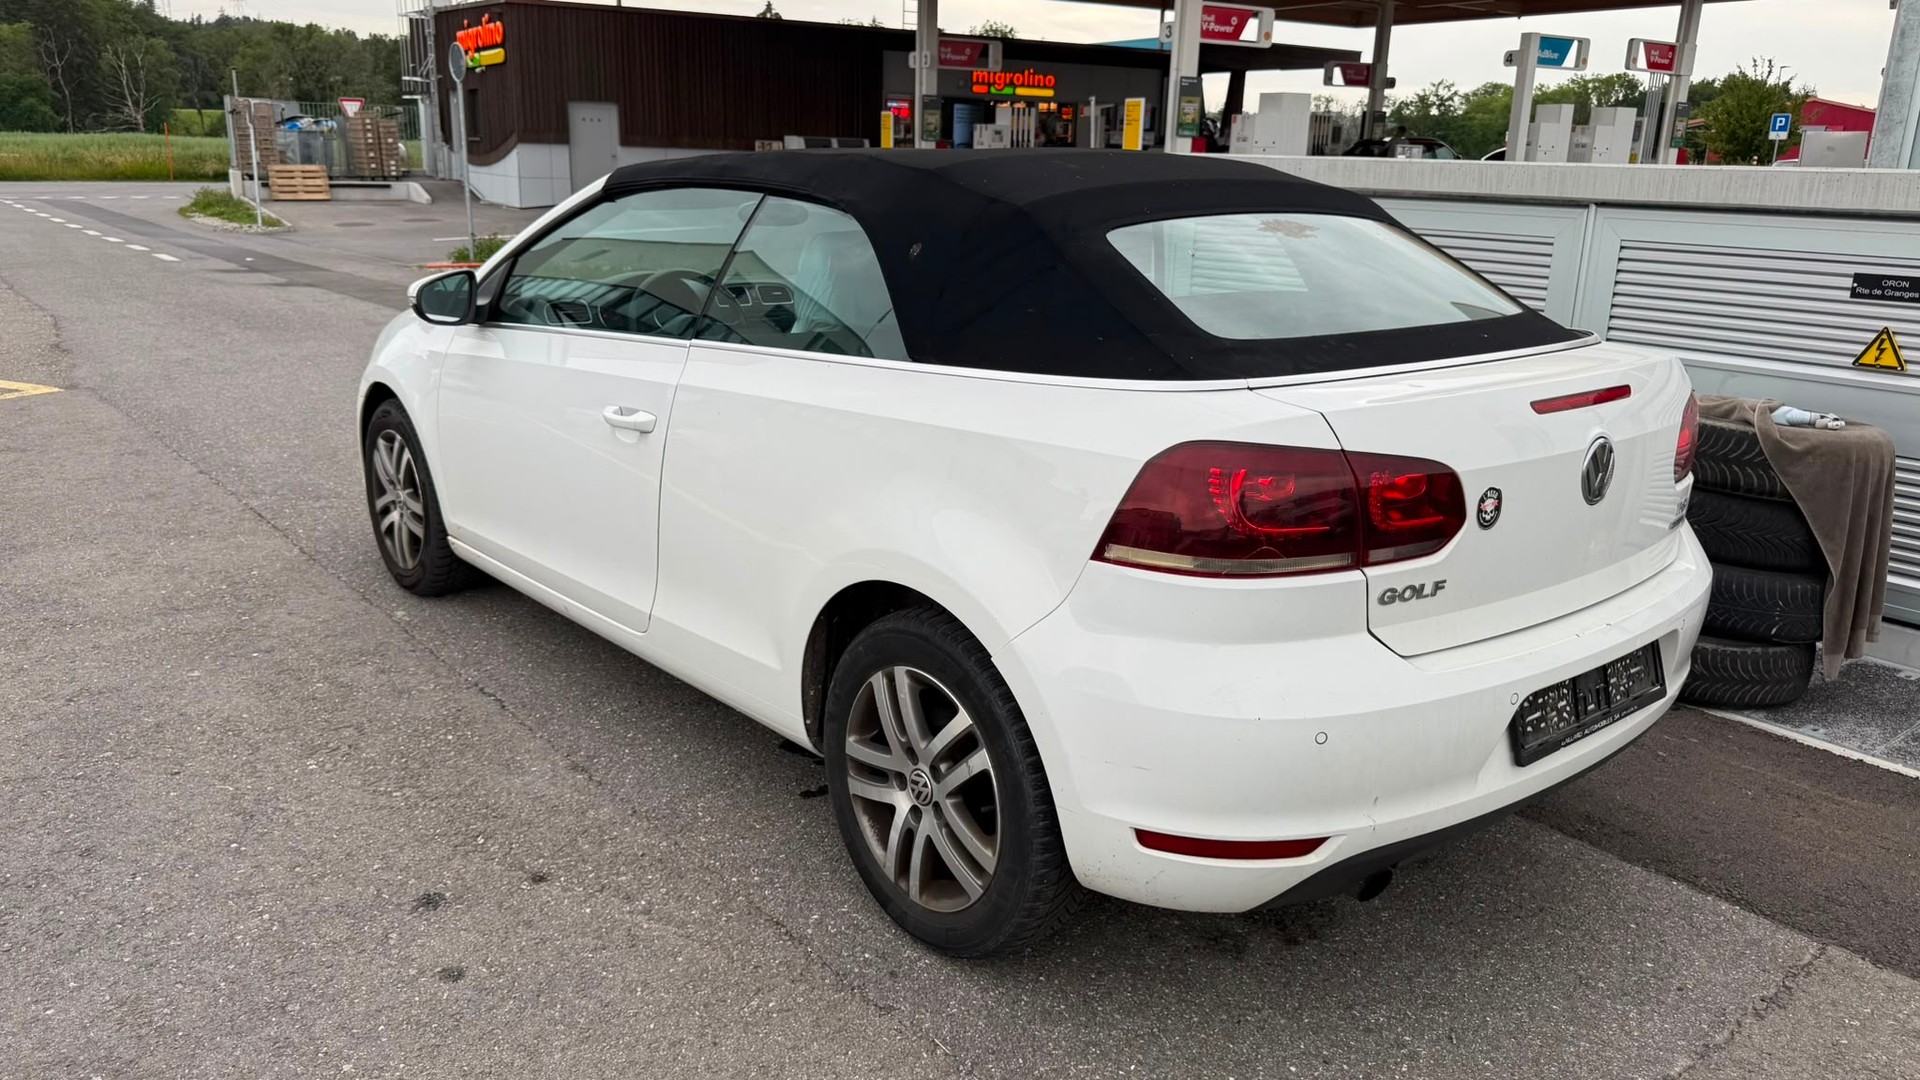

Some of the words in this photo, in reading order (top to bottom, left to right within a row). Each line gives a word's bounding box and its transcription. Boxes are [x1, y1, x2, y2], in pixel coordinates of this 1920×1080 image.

[1165, 25, 1172, 38] 3
[1201, 22, 1235, 33] V-Power
[456, 13, 503, 59] migrolino
[1505, 53, 1513, 64] 4
[972, 69, 1055, 90] migrolino
[1775, 117, 1786, 131] P
[1882, 279, 1910, 288] ORON
[1856, 286, 1870, 295] Rte
[1871, 288, 1882, 296] de
[1884, 288, 1920, 299] Granges
[1376, 579, 1448, 606] GOLF
